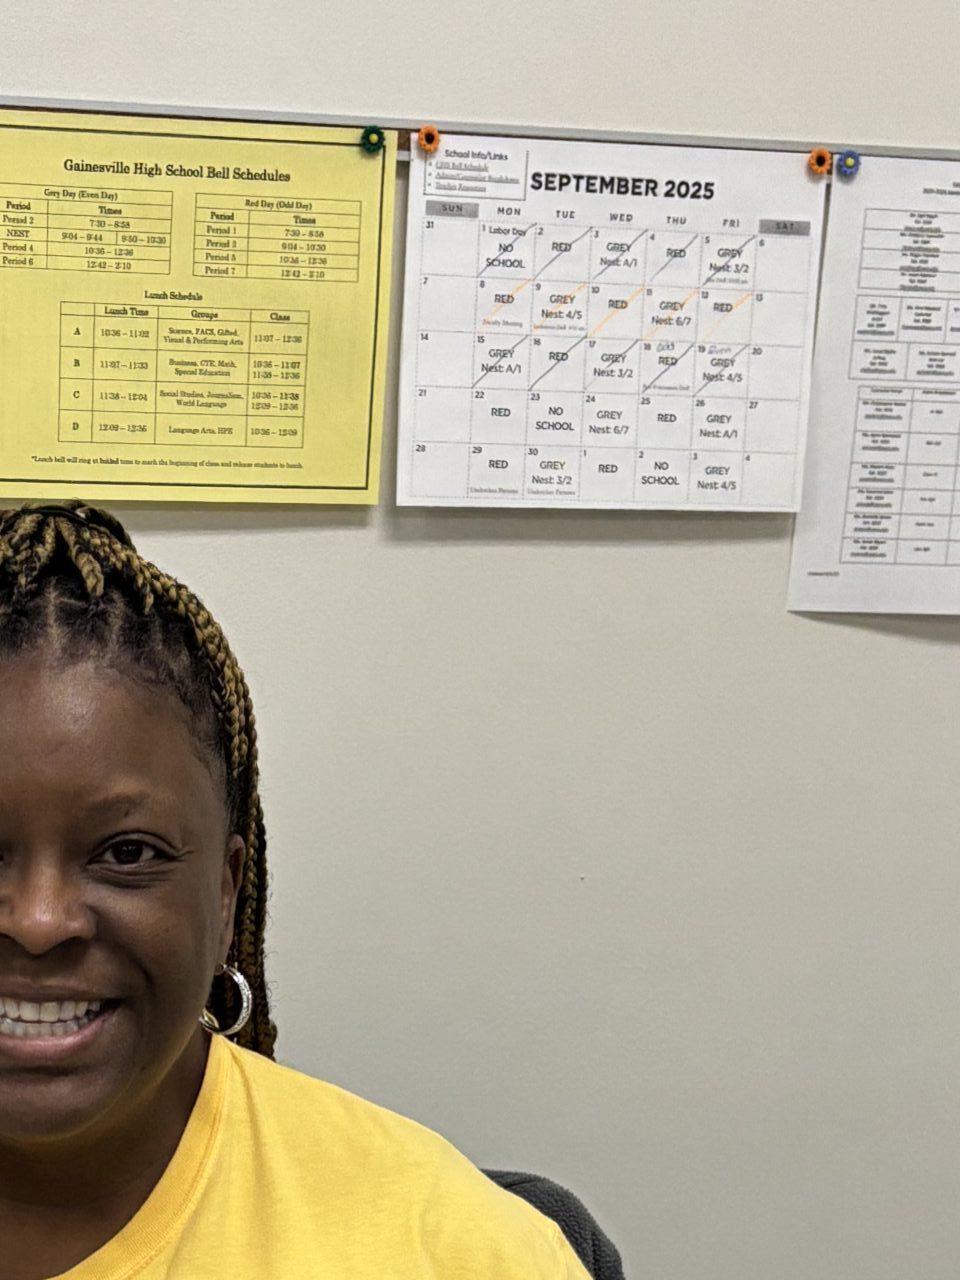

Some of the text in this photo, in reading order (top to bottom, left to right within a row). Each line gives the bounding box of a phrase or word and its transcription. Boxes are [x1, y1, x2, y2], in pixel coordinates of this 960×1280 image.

[445, 149, 508, 160] School Info/Links
[64, 159, 290, 182] Gainesville High School Bell Schedules
[531, 172, 658, 196] SEPTEMBER
[664, 180, 714, 199] 2025
[498, 207, 739, 227] MON TUE WED THU FRI
[74, 359, 80, 367] B
[491, 408, 511, 417] RED
[549, 407, 563, 415] NO
[597, 410, 622, 419] GREY
[657, 414, 677, 422] RED
[707, 415, 732, 423] GREY
[73, 422, 79, 430] D
[536, 421, 574, 431] SCHOOL
[489, 460, 508, 469] RED
[540, 461, 565, 470] GREY
[599, 464, 618, 473] RED
[654, 462, 669, 470] NO
[705, 466, 730, 475] GREY
[642, 476, 679, 485] SCHOOL
